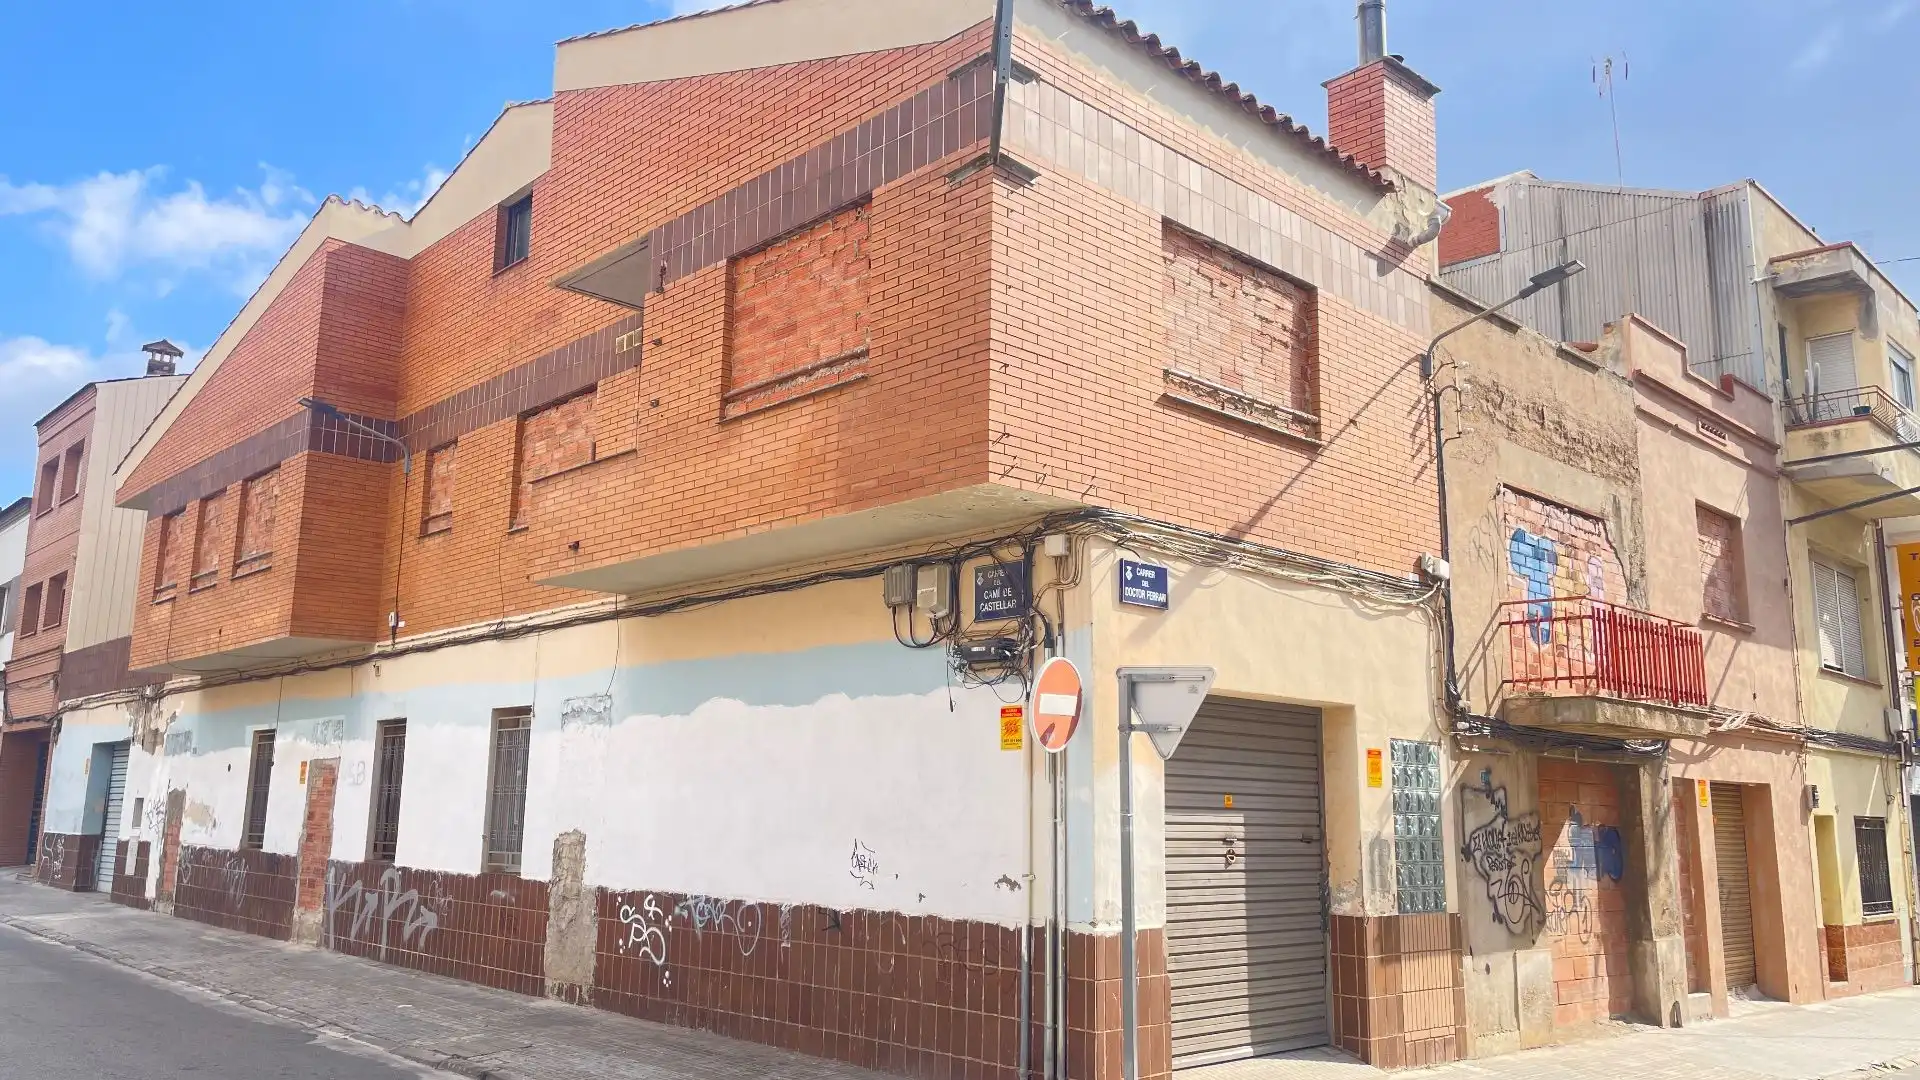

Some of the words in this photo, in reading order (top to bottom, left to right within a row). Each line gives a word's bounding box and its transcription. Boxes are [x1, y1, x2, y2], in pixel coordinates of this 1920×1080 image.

[1136, 567, 1156, 579] CARRER
[1141, 580, 1150, 588] DEL
[1124, 586, 1146, 600] DOCTOR
[980, 599, 1017, 612] CASTELLAR
